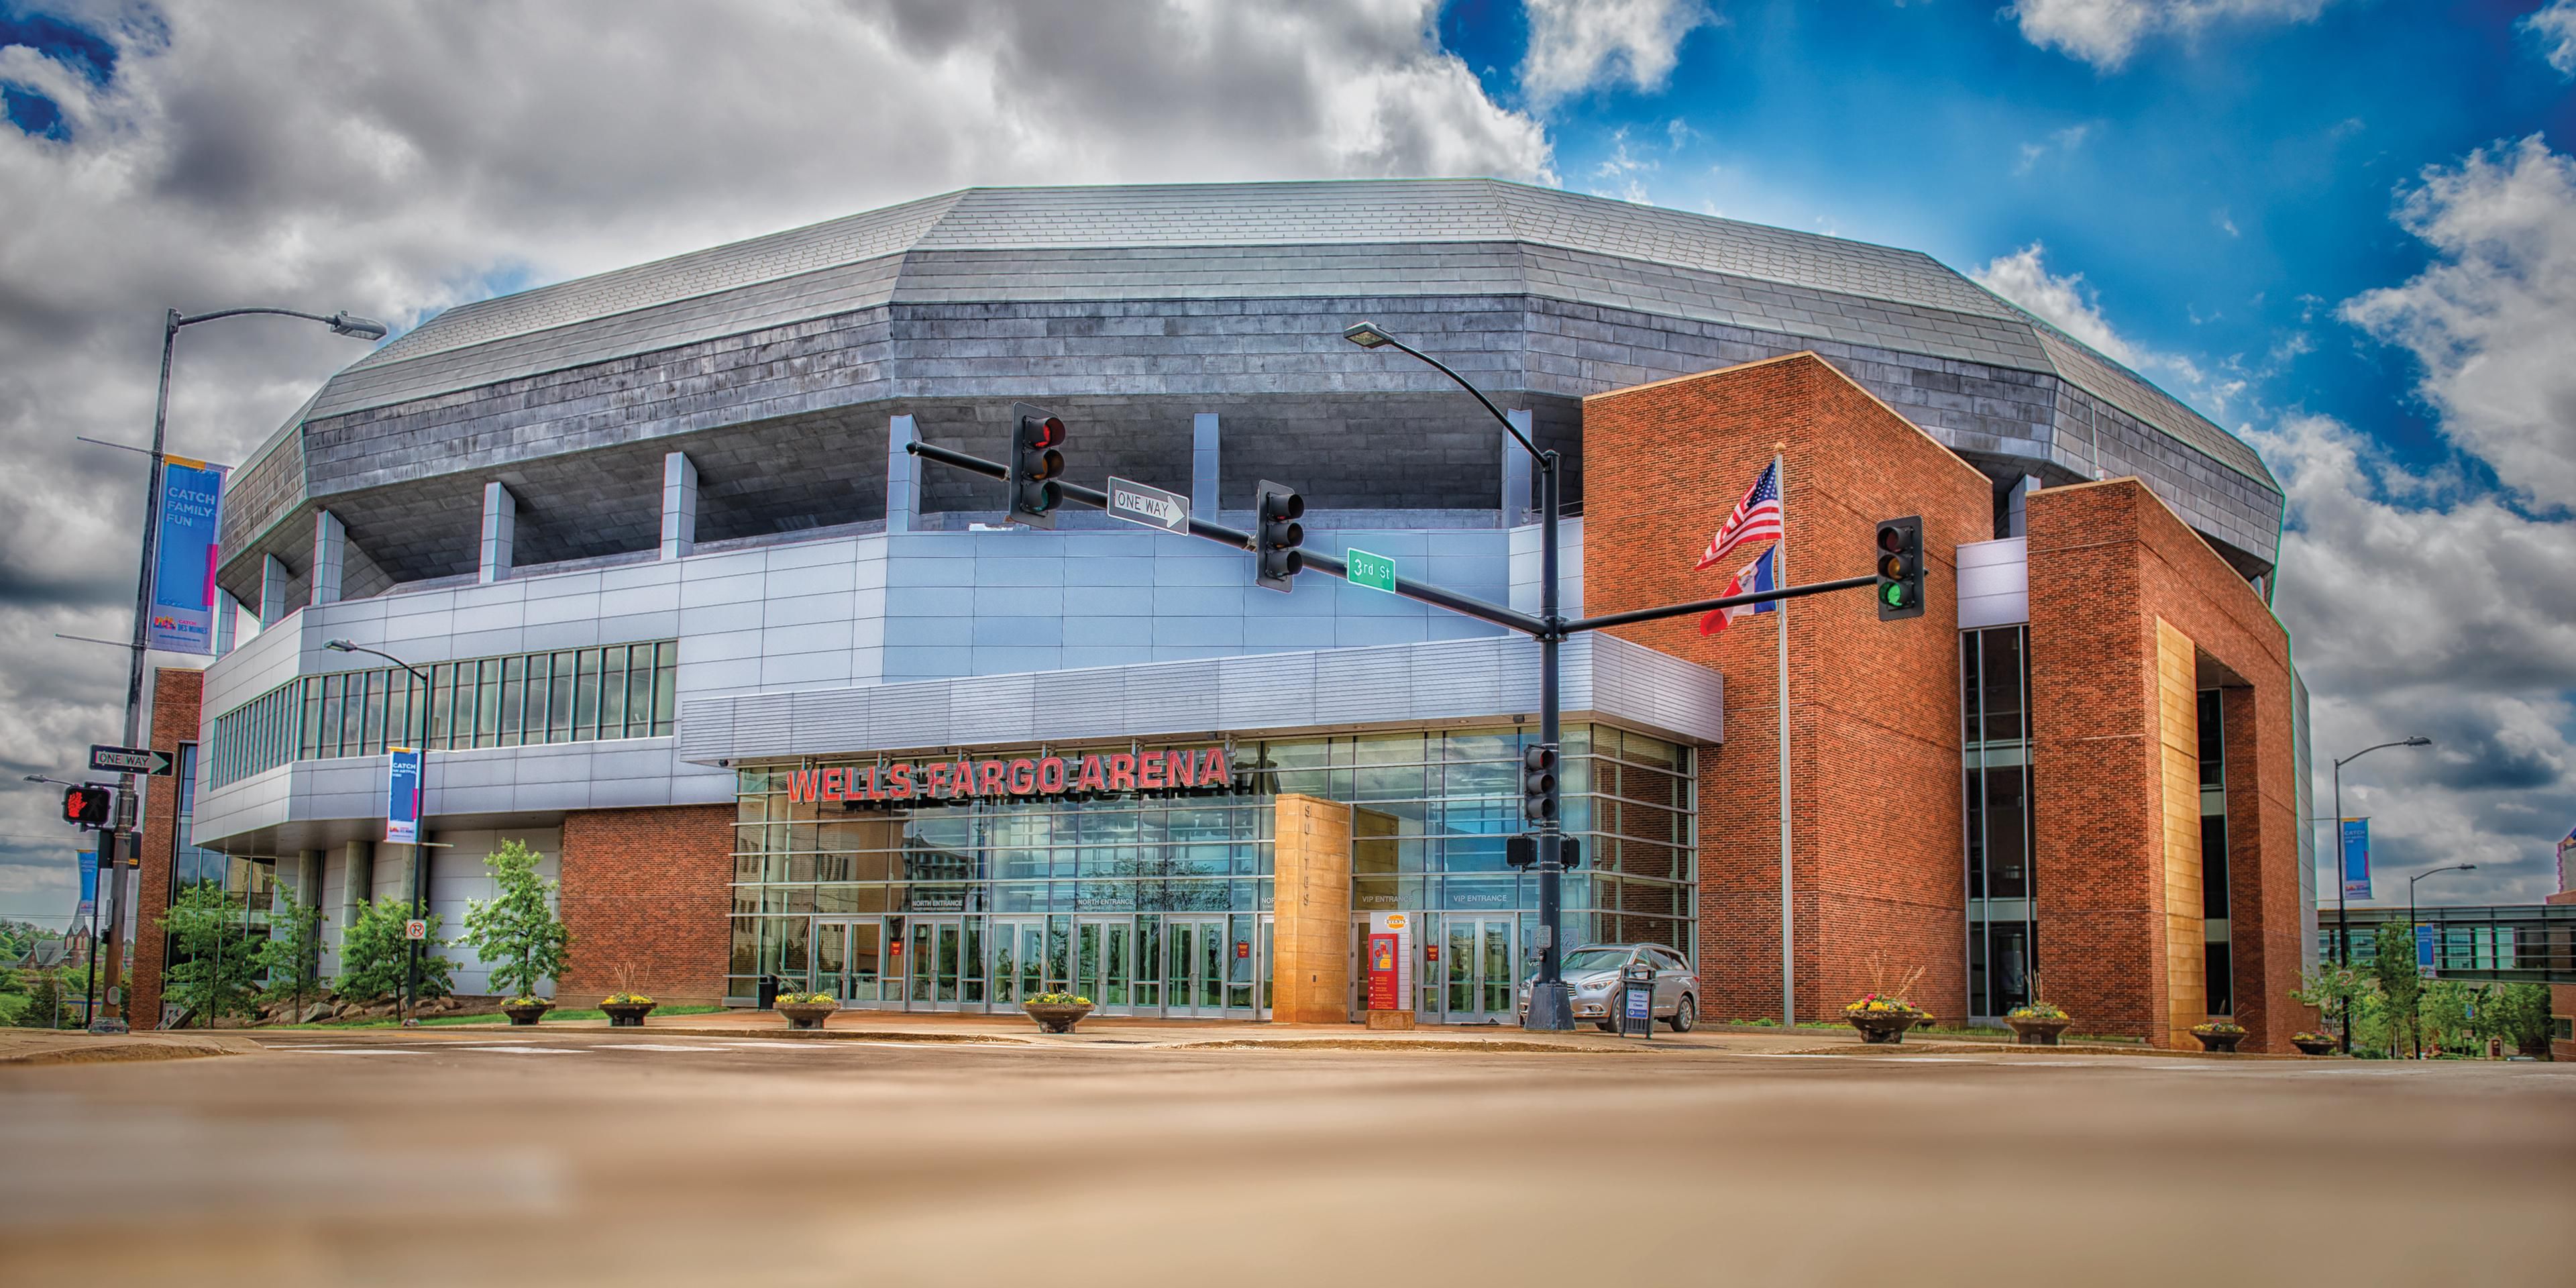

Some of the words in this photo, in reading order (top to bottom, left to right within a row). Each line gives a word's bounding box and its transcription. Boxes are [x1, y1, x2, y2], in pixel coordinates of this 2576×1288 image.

[168, 487, 215, 505] CATCH
[1118, 492, 1141, 511] ONE
[1145, 498, 1169, 517] WAY
[167, 500, 213, 517] FAMILY
[166, 513, 193, 527] FUN
[1354, 558, 1374, 576] 3rd
[1379, 566, 1390, 580] St
[100, 753, 121, 764] ONE
[127, 755, 149, 767] WAY
[787, 763, 916, 803] WELLS
[926, 756, 1065, 798] FARGO
[1076, 747, 1230, 792] ARENA
[1303, 805, 1311, 906] SUITES
